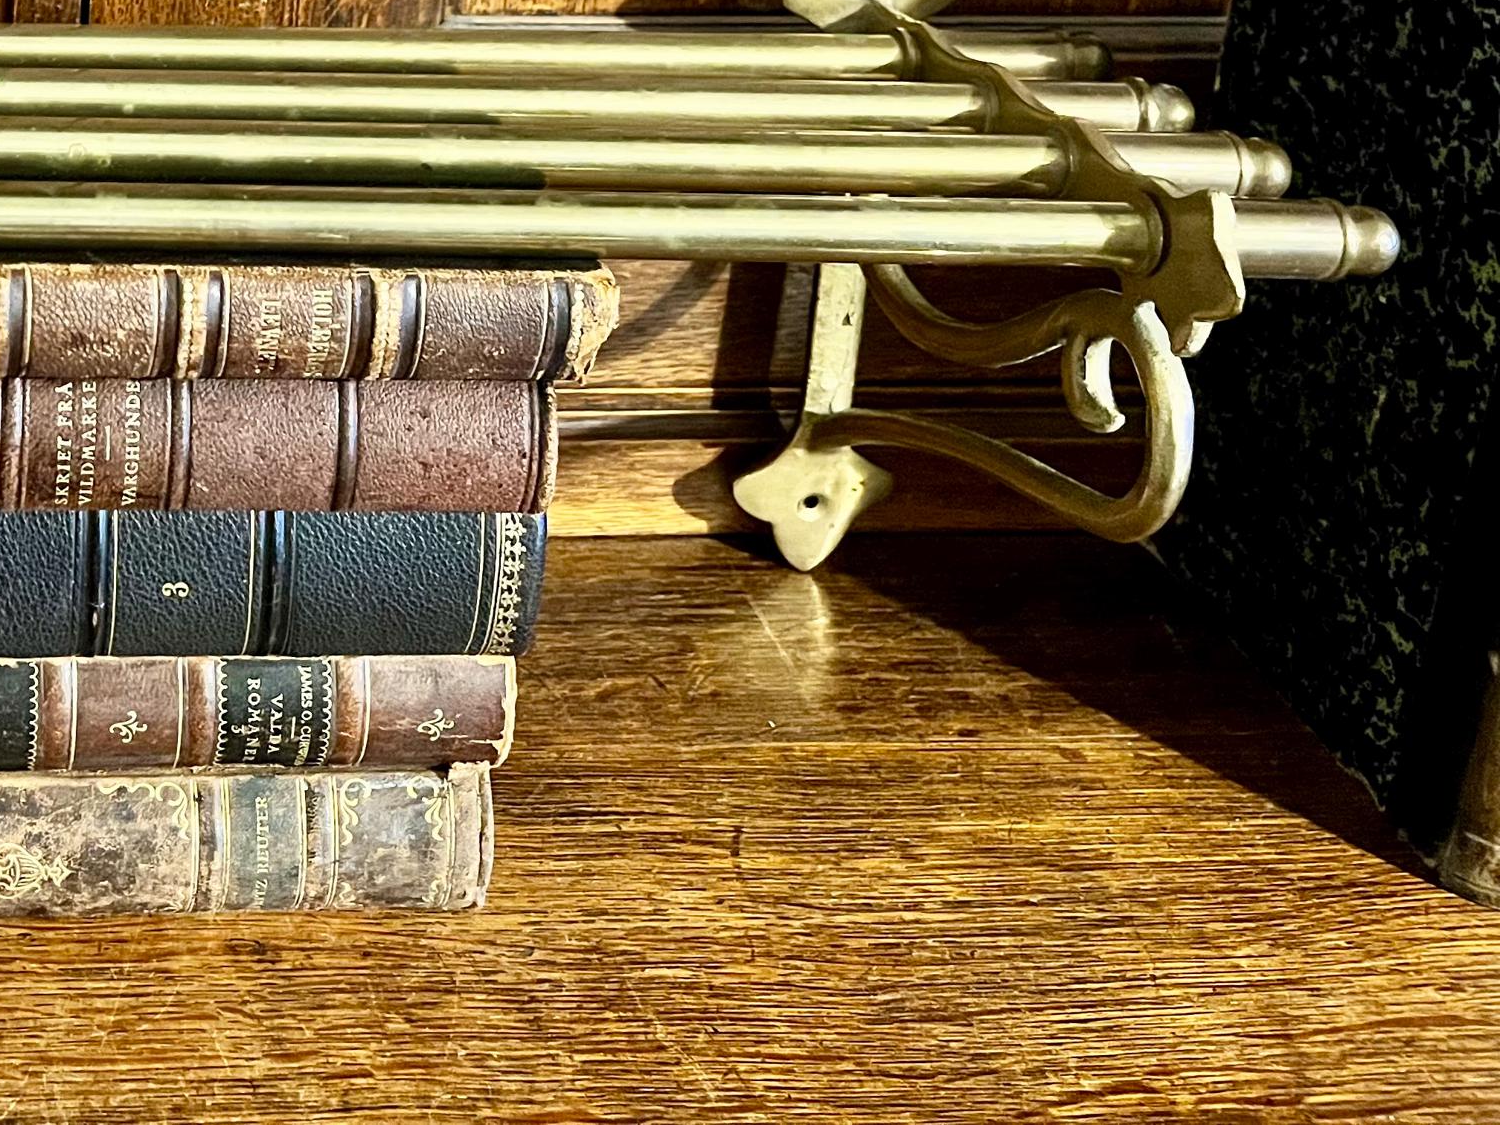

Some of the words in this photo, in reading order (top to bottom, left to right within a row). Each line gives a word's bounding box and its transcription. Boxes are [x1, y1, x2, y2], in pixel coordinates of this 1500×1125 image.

[55, 435, 72, 505] SKRIET
[161, 581, 189, 597] 3
[298, 665, 313, 708] JAMES
[267, 693, 284, 754] VALDA
[300, 710, 313, 724] O.
[255, 796, 270, 874] REUTER
